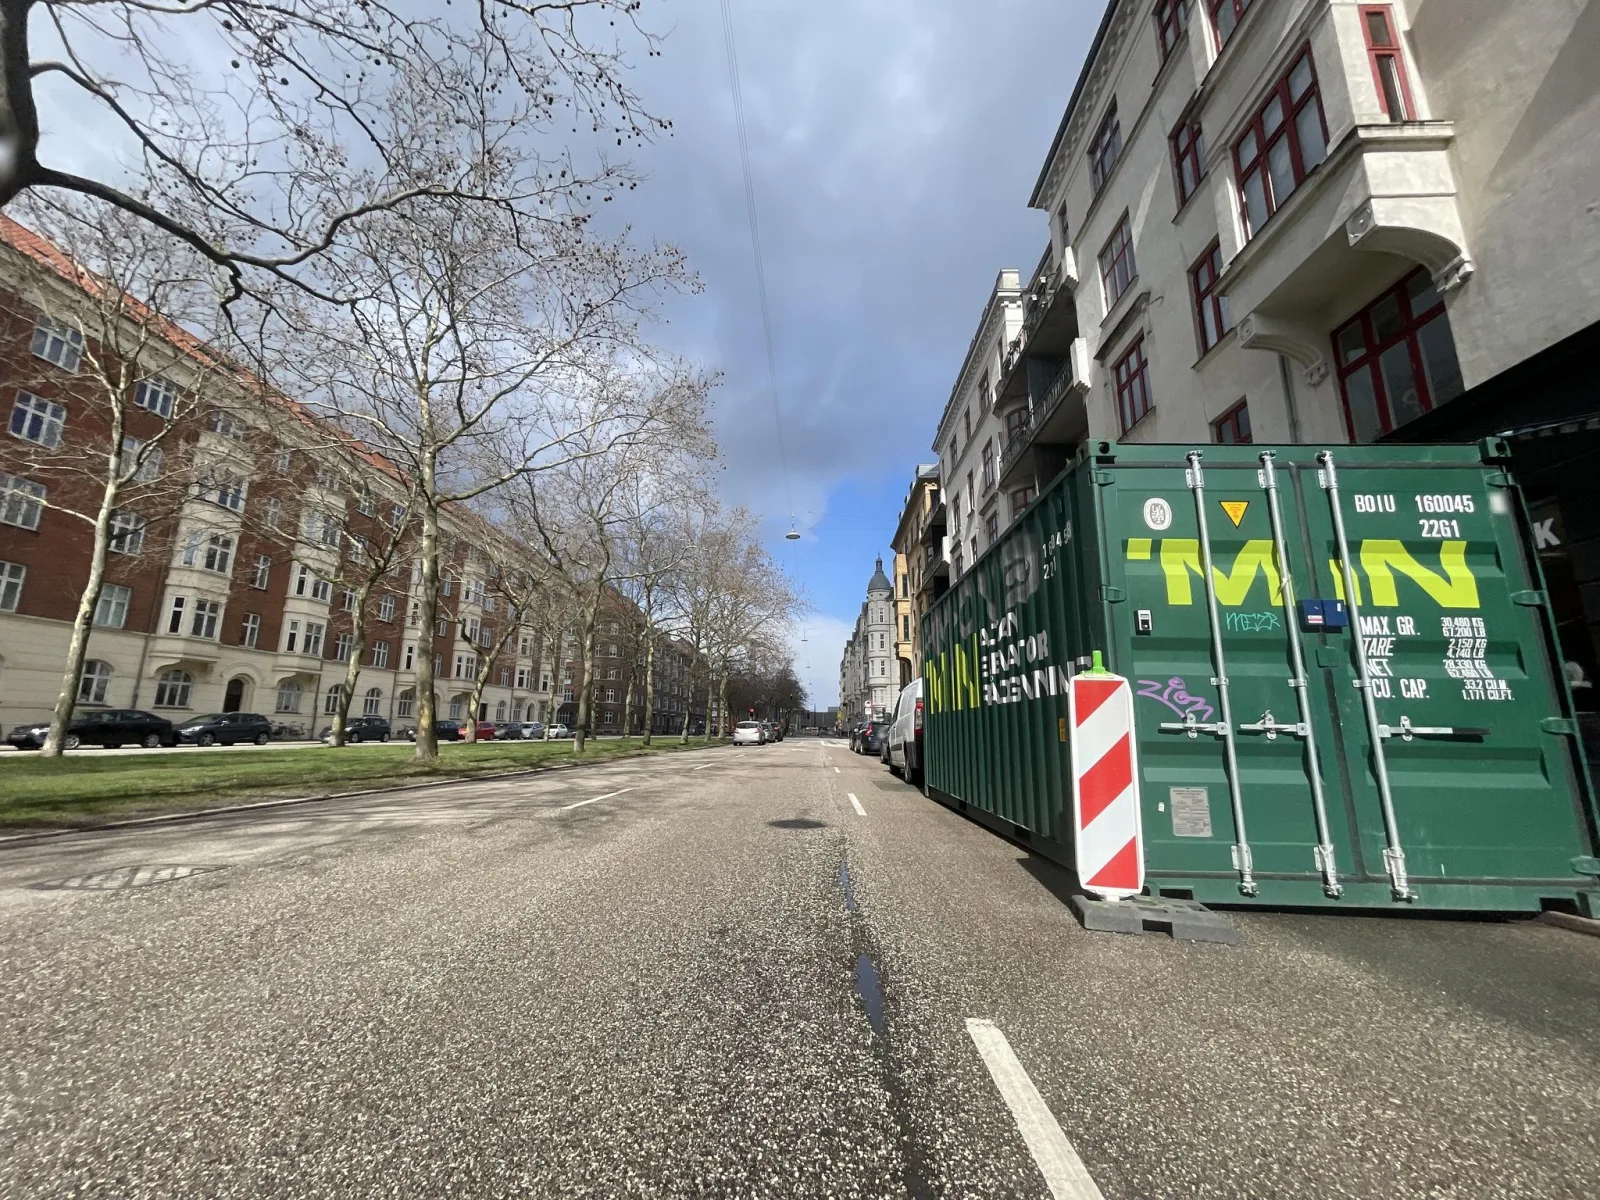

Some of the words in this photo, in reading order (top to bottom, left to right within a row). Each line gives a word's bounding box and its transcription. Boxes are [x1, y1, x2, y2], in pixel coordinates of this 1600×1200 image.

[1354, 494, 1396, 513] BOIU
[1414, 494, 1475, 513] 160045
[1418, 519, 1461, 538] 22G1
[1360, 616, 1395, 635] MAX.
[1396, 616, 1420, 635] GR.
[1471, 617, 1484, 627] KG
[1473, 627, 1486, 637] LB
[1362, 637, 1396, 656] TARE
[1474, 639, 1488, 649] KG
[1472, 648, 1485, 658] LB
[1366, 658, 1393, 676] NET
[1474, 659, 1488, 669] KG
[1478, 668, 1494, 678] LB
[1371, 678, 1395, 698] CU.
[1399, 678, 1430, 698] CAP.
